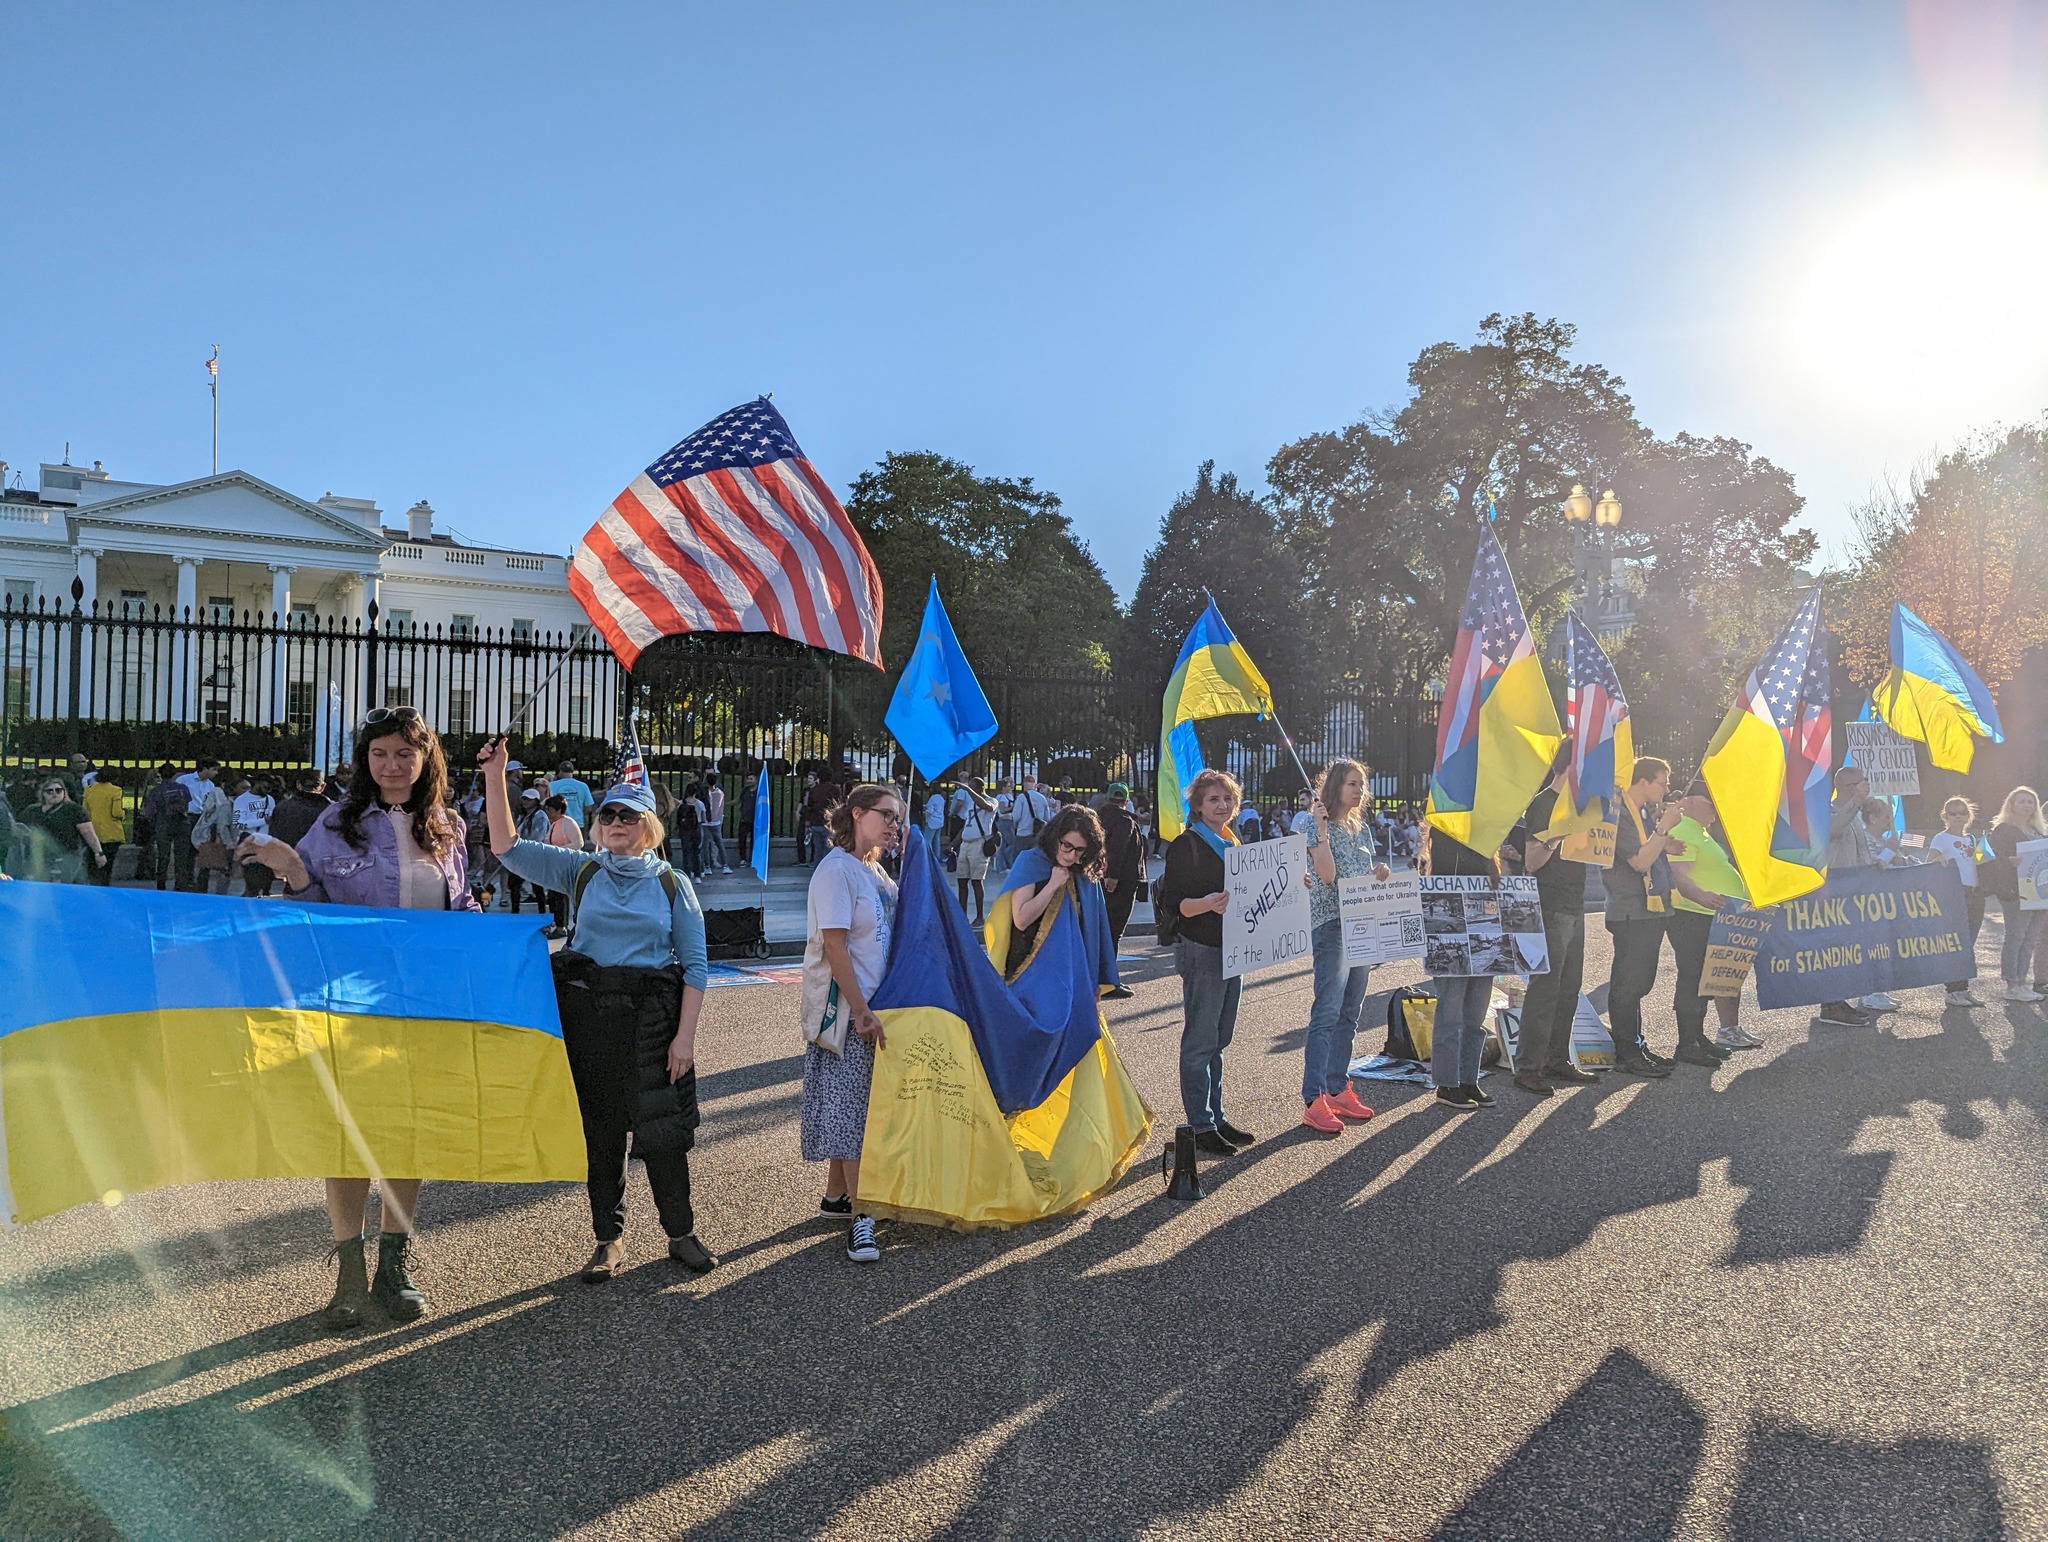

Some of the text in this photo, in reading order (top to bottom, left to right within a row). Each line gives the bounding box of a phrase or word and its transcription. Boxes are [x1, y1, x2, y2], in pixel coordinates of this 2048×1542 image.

[1851, 748, 1875, 770] STOP
[1230, 842, 1299, 875] UKRAINE is
[1345, 886, 1357, 895] Ask
[1370, 882, 1387, 891] What
[1389, 880, 1412, 889] ordinary
[1468, 876, 1537, 892] MASACRE
[1234, 865, 1289, 934] the SHIELD
[1342, 896, 1362, 907] people
[1377, 893, 1385, 901] do
[1386, 892, 1394, 900] for
[1396, 890, 1418, 899] Ukraine
[1782, 891, 1942, 931] THANK YOU USA
[1716, 913, 1757, 929] WOULD
[1227, 929, 1308, 968] of the WORLD
[1728, 932, 1758, 947] YOUR
[1710, 949, 1733, 960] HELP
[1770, 932, 1963, 974] for STANDING with UKRAINE!
